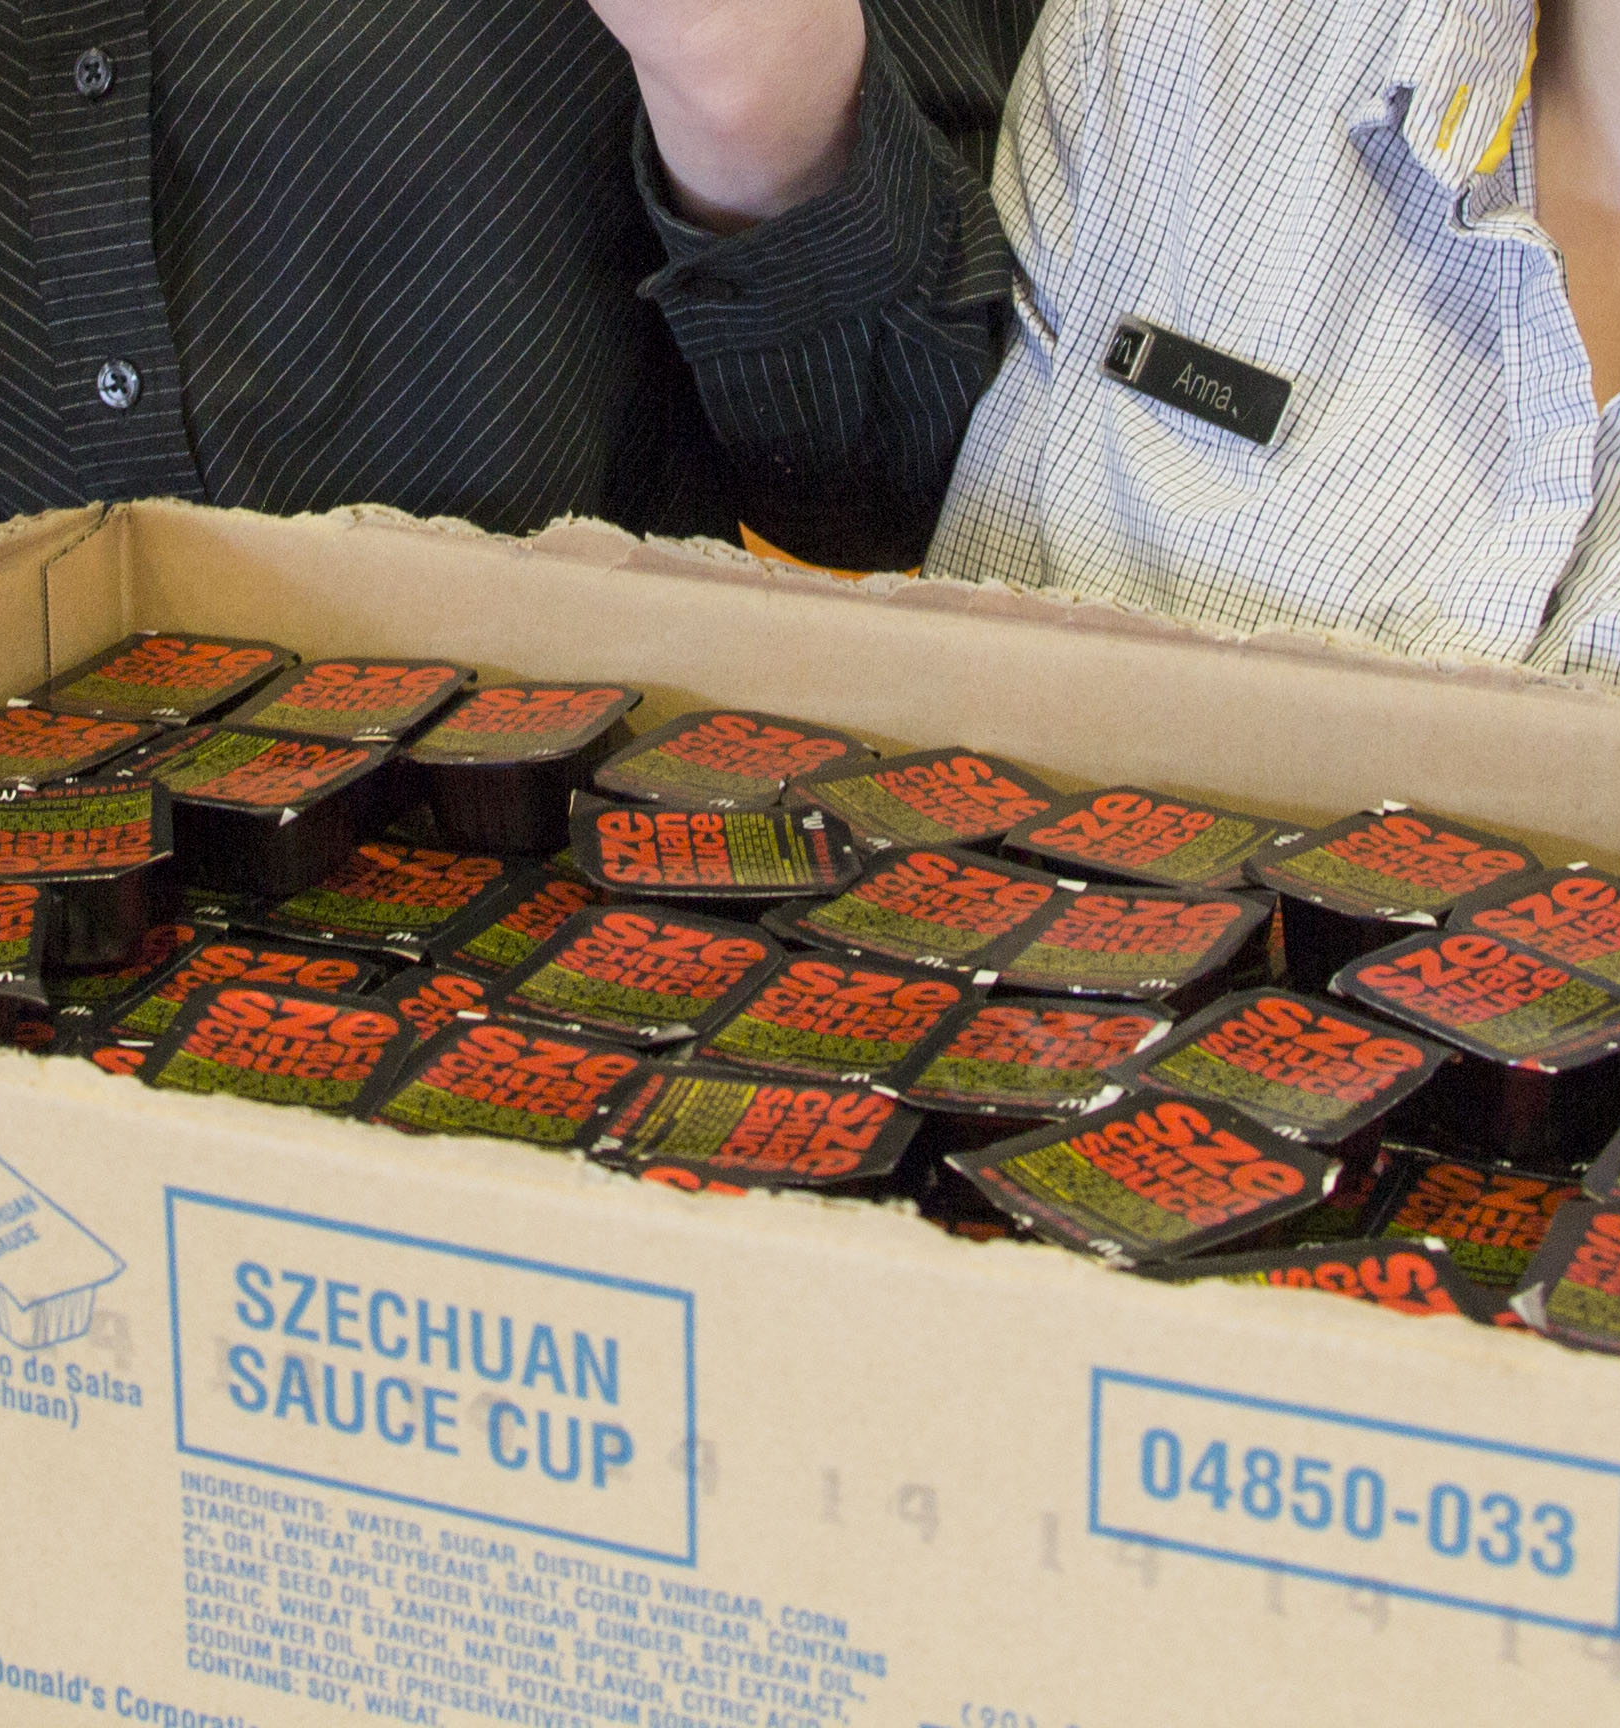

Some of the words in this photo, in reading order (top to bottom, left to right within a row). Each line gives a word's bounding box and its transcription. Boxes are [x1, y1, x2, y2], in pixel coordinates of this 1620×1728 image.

[22, 1355, 57, 1388] de
[65, 1362, 144, 1409] Salsa
[234, 1260, 622, 1408] SZECHUAN
[226, 1344, 462, 1460] SAUCE
[487, 1398, 638, 1491] CUP
[1139, 1427, 1578, 1579] 04850-033
